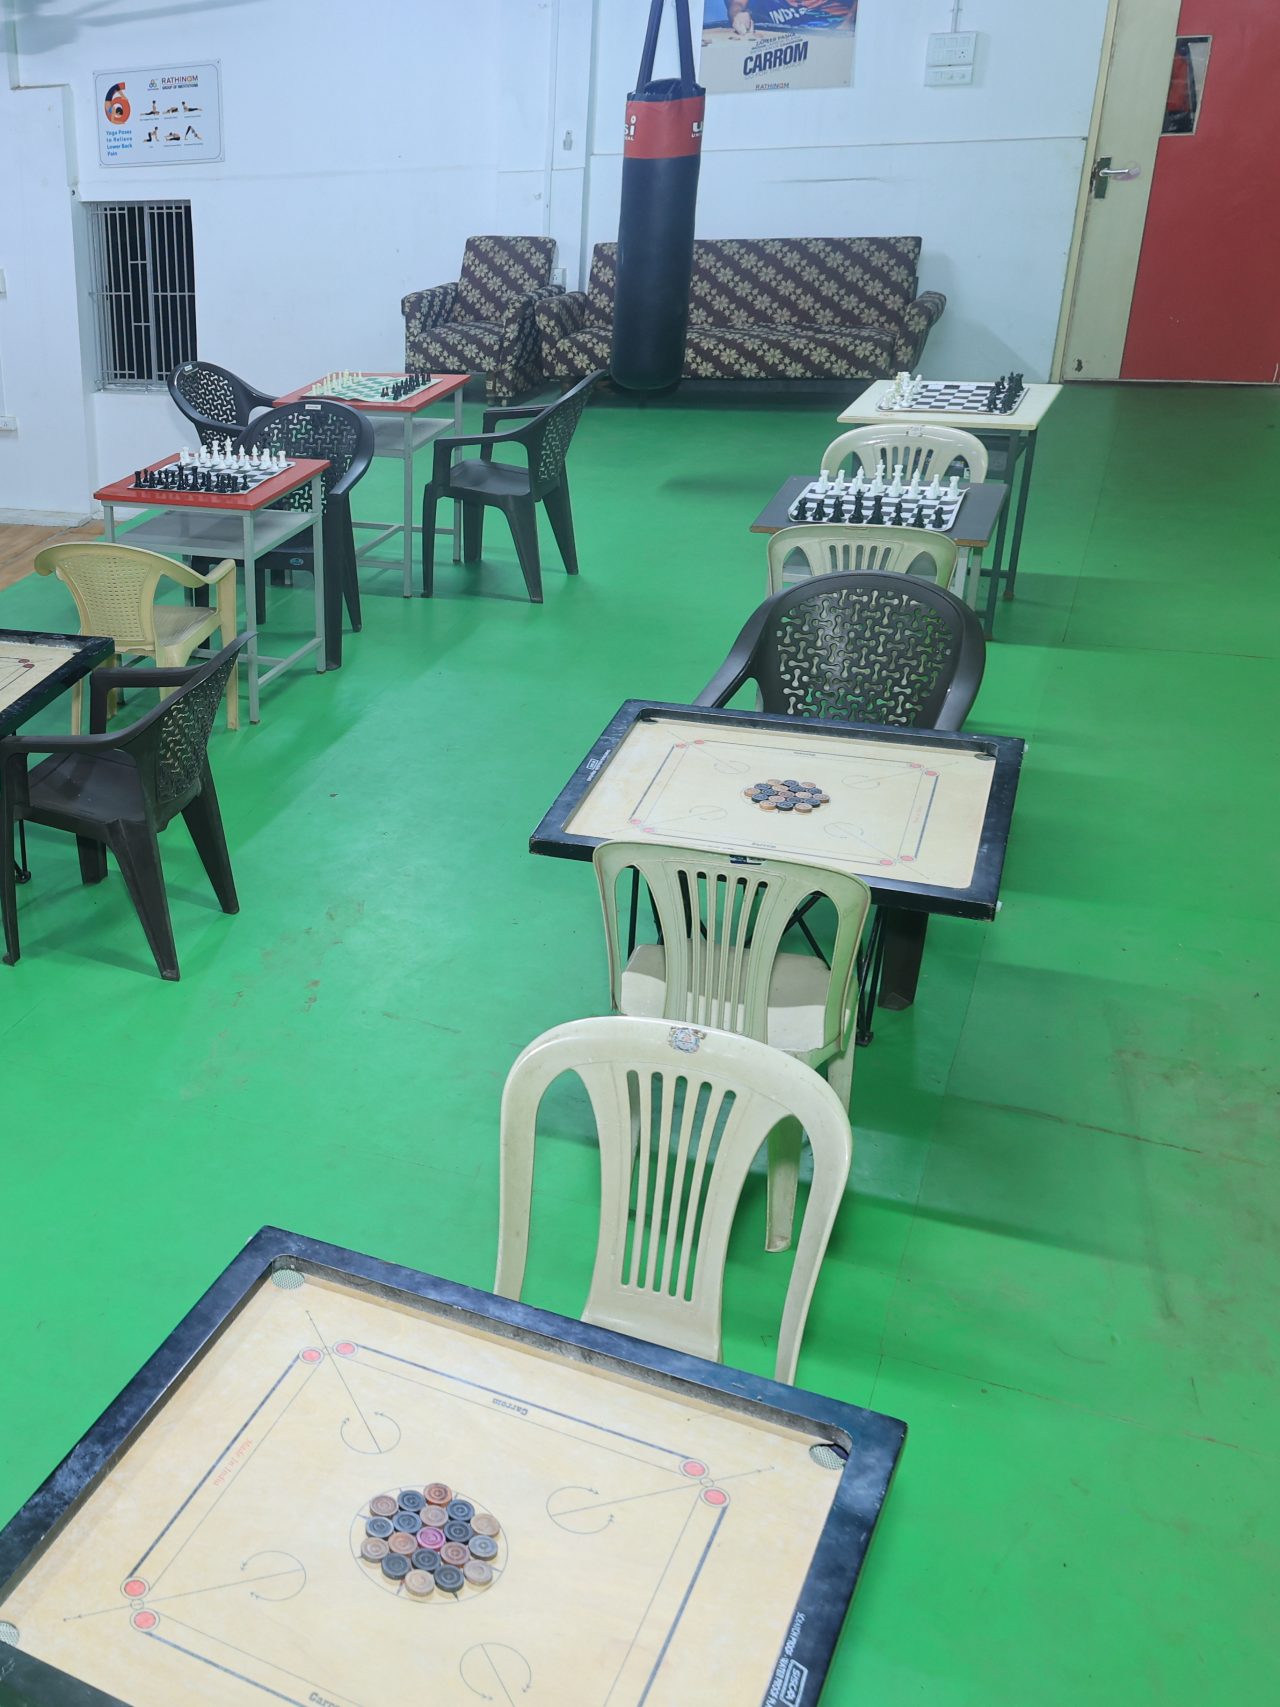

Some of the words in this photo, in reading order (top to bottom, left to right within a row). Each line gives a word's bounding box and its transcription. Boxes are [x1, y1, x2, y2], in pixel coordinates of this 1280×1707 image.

[743, 40, 809, 76] CARROM
[161, 75, 199, 84] RATHINOM
[492, 1398, 529, 1416] Carrom
[784, 1636, 796, 1656] PROOF
[775, 1657, 789, 1676] WATER
[770, 1677, 782, 1698] PROOF
